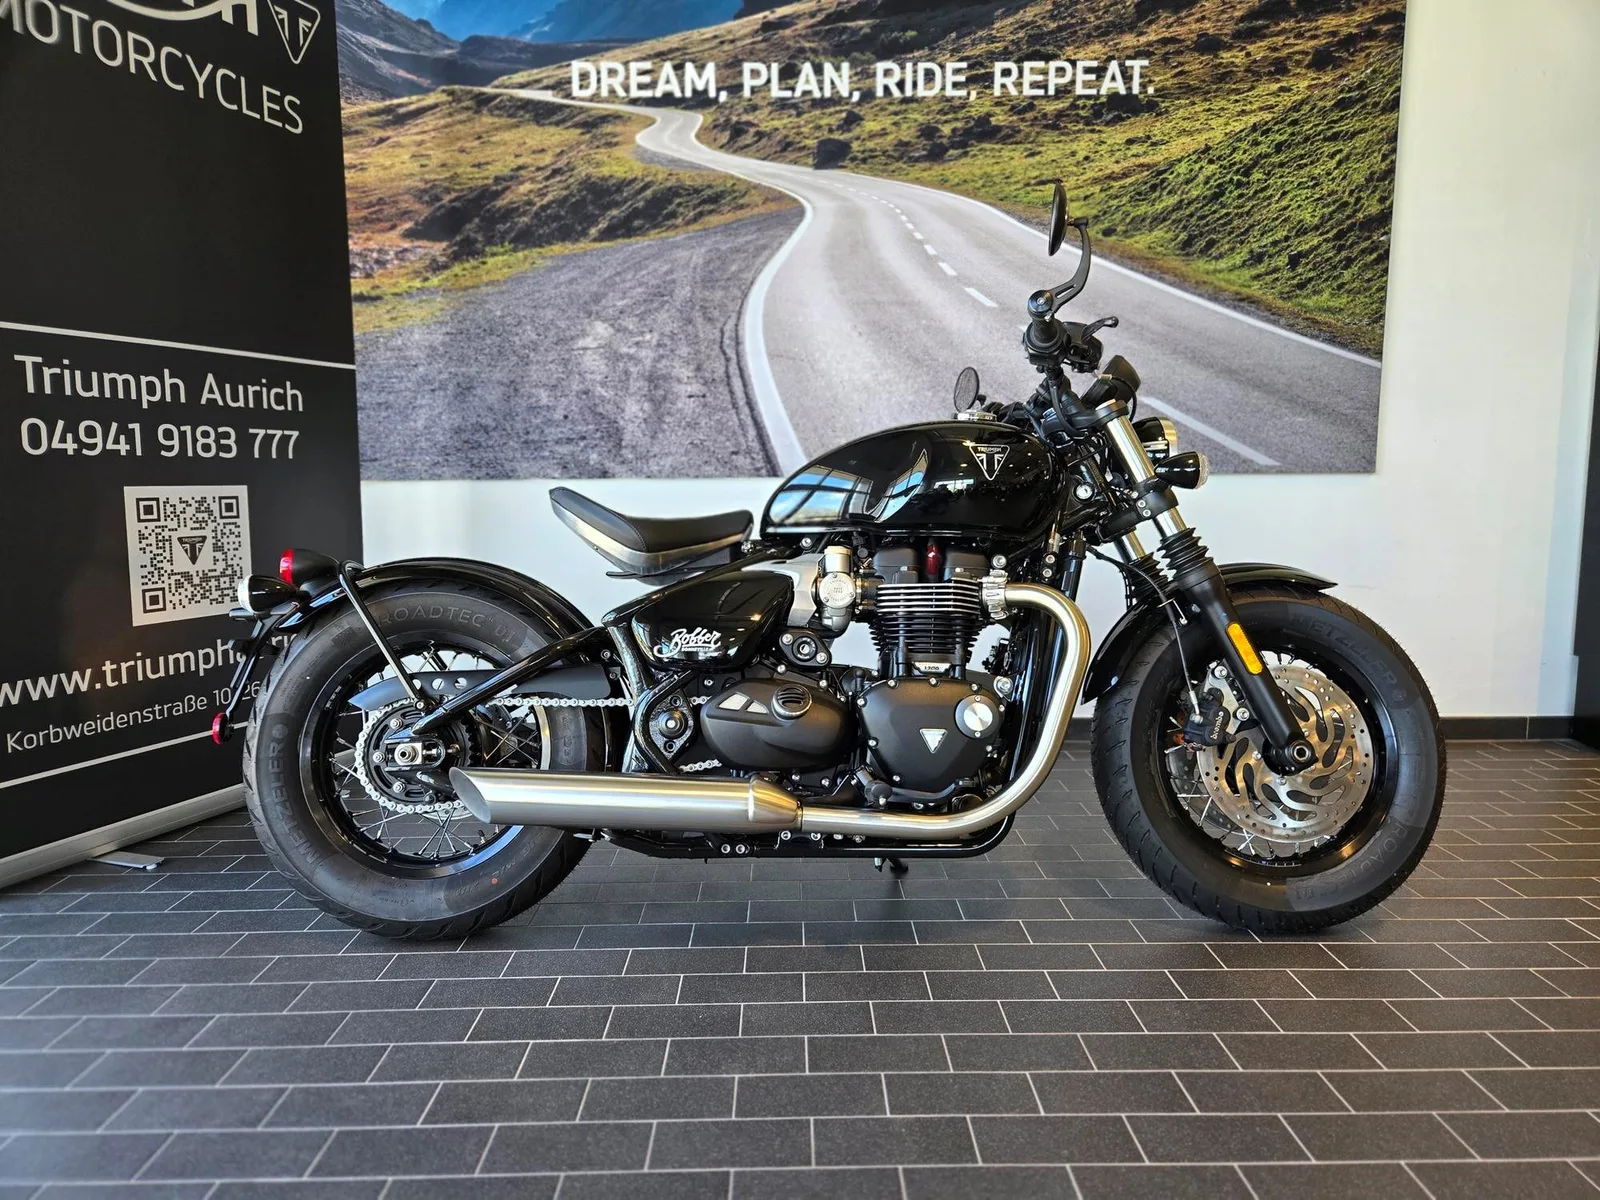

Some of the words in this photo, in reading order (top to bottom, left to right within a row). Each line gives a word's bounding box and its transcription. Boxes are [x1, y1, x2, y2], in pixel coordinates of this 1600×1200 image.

[571, 60, 728, 102] DREAM,
[742, 61, 861, 101] PLAN,
[876, 61, 977, 101] RIDE,
[993, 59, 1155, 96] REPEAT.
[14, 354, 186, 409] Triumph
[200, 373, 304, 412] Aurich
[20, 417, 142, 456] 04941
[157, 423, 237, 459] 9183
[248, 428, 300, 460] 777
[653, 626, 722, 658] Bobber
[6, 694, 207, 754] Korbweidenstraße
